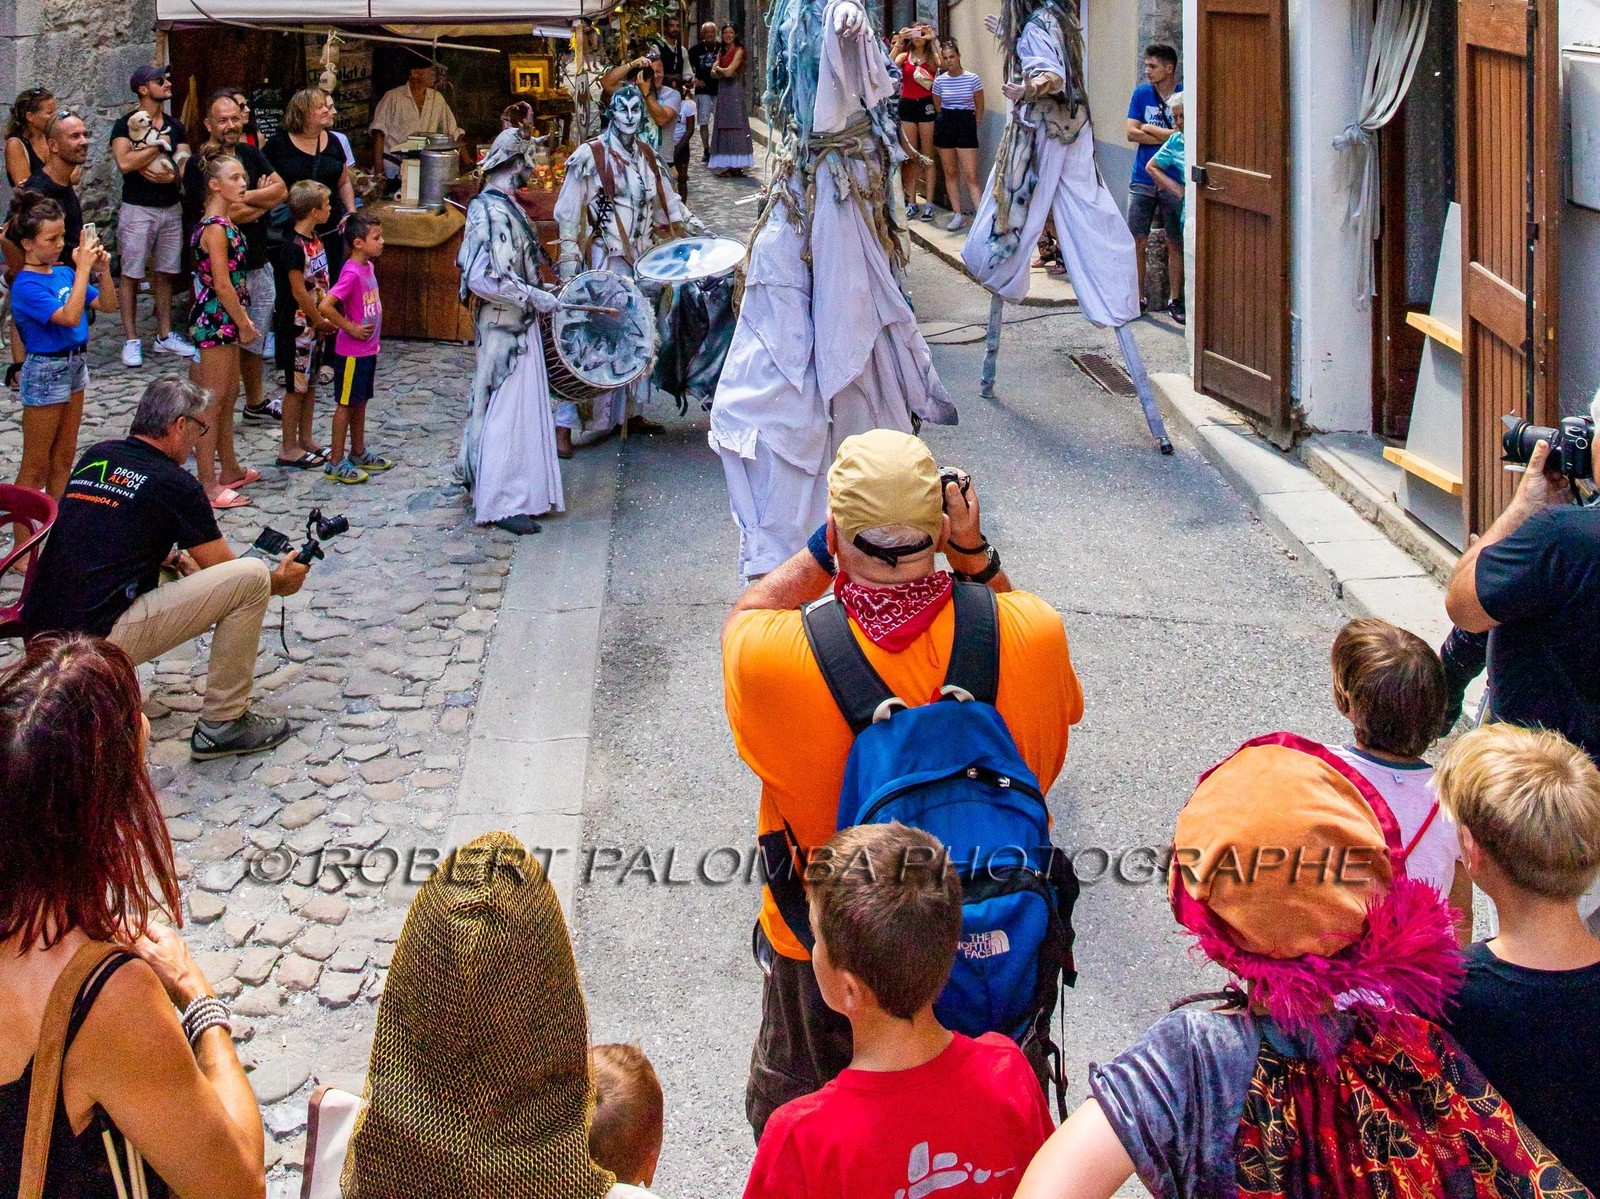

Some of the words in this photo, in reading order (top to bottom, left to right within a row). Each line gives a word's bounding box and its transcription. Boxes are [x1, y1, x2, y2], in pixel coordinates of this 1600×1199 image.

[113, 466, 148, 484] DRONE
[108, 474, 141, 491] ALP04
[969, 932, 991, 944] THE
[964, 948, 991, 959] FACE
